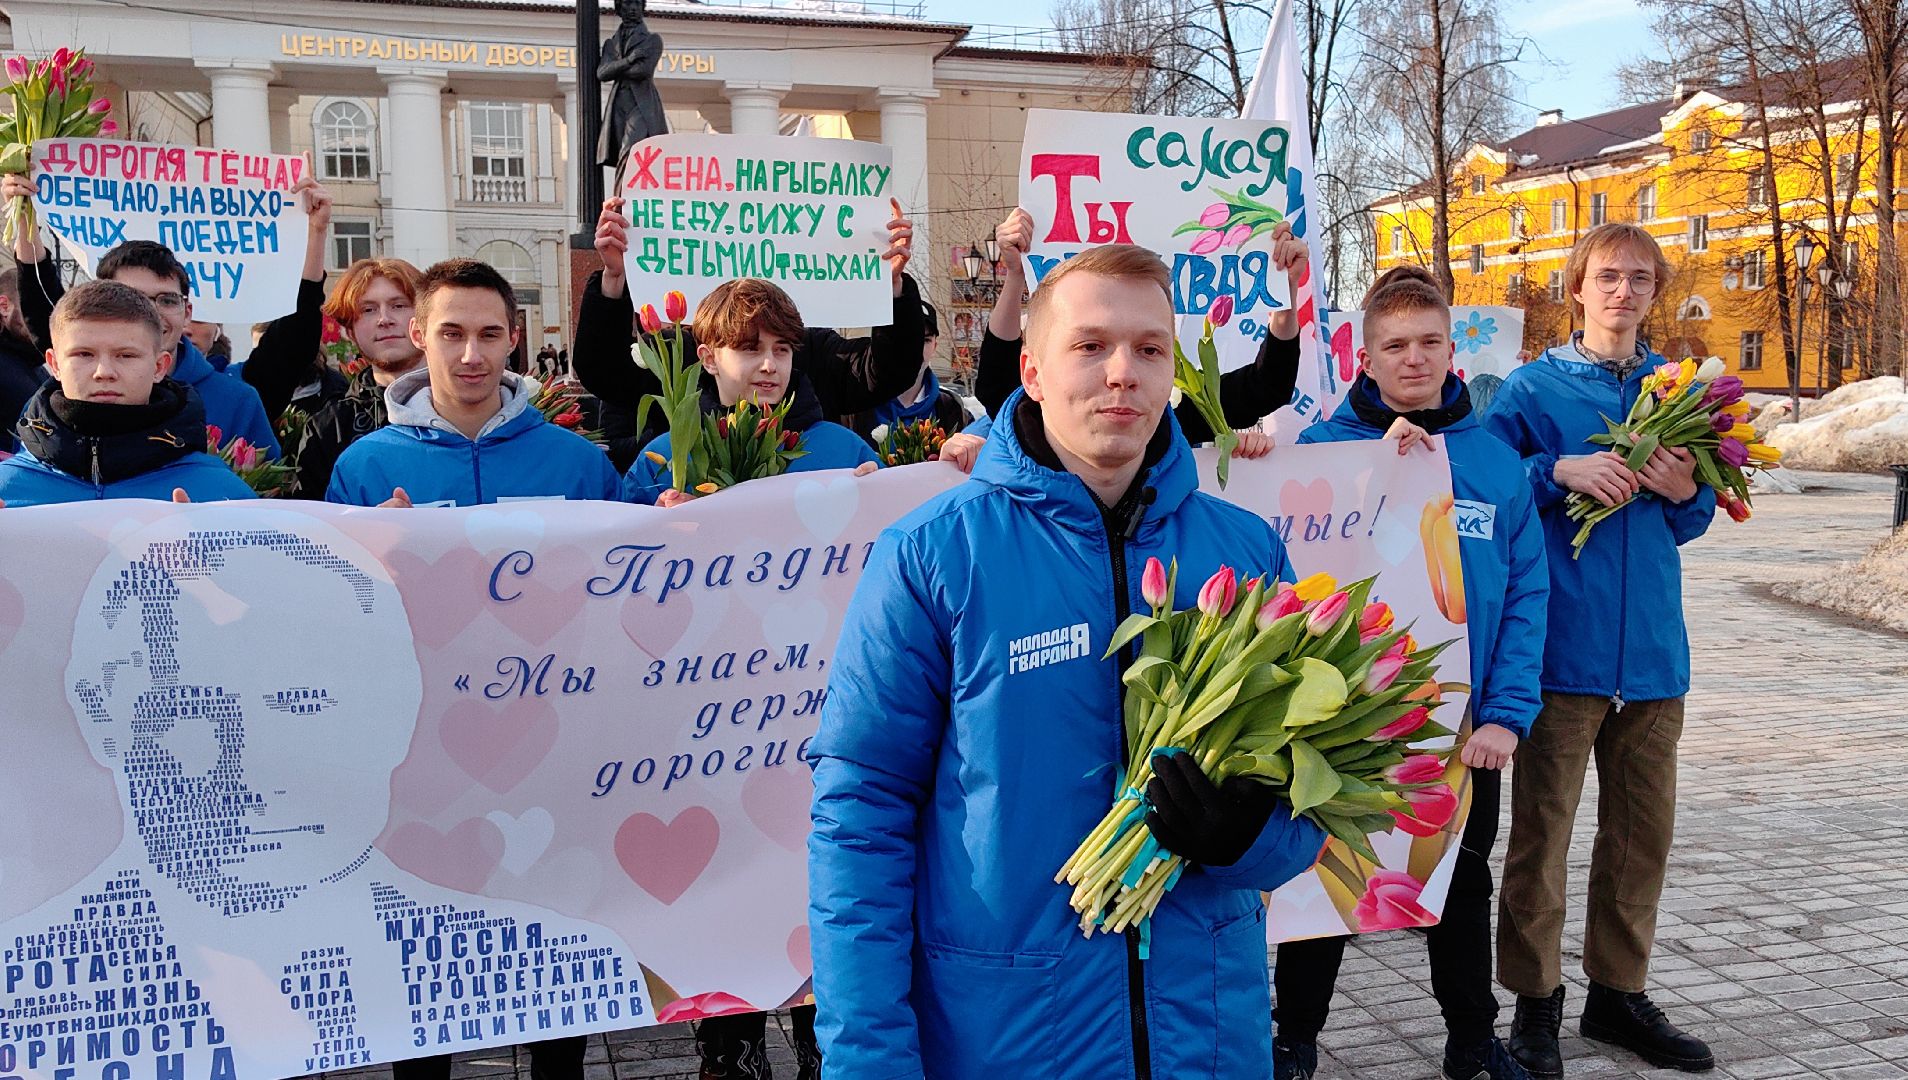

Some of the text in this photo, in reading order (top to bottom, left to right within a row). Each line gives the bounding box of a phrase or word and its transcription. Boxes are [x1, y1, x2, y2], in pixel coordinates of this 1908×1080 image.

[280, 33, 478, 64] ЦЕНТРАЛЬНЫЙ
[657, 52, 715, 73] ТУРЫ
[39, 142, 303, 191] ДОРОГАЯ ТЁЩА!
[626, 145, 891, 197] ЖЕНА, НА РЫБАЛКУ
[36, 173, 295, 218] ОБЕЩАЮ, НА ВЫХО-
[632, 199, 854, 238] НЕ ЕДУ, СИЖУ С
[158, 220, 279, 255] ПОЕДЕМ
[184, 261, 245, 300] АЧУ
[130, 560, 207, 570] ПОДДЕРЖКА
[142, 552, 208, 562] ХРАБРОСТЬ
[121, 569, 169, 580] ЧЕСТЬ
[487, 549, 535, 602] С
[113, 579, 174, 590] КРАСОТА
[1010, 623, 1090, 657] МОЛОДАЯ
[642, 643, 826, 687] знаем,
[169, 686, 223, 699] СЕМЬЯ
[277, 689, 328, 699] ПРАВДА
[170, 706, 206, 717] ДОЛГ
[290, 703, 322, 713] СИЛА
[124, 762, 182, 773] ВНИМАНИЕ
[129, 776, 185, 788] НАДЕЖДА
[130, 783, 203, 799] БУДУЩЕЕ
[222, 793, 263, 805] МАМА
[131, 796, 174, 809] ЧЕСТЬ
[138, 815, 174, 827] ДОЧЬ
[138, 819, 239, 835] ПРИВЛЕКАТЕЛЬНАЯ
[187, 826, 251, 841] БАБУШКА
[175, 842, 282, 861] ВЕРНОСТЬ ВЕСНА
[117, 869, 140, 878] ВЕРА
[157, 858, 221, 873] ВЕЛИЧИЕ
[166, 867, 219, 879] НАДЕЖНОСТЬ
[187, 881, 271, 894] СМЕЛОСТЬ ДРУЖБА
[81, 889, 152, 905] НАДЕЖНОСТЬ
[196, 890, 237, 903] СЕСТРА
[74, 900, 157, 922] ПРАВДА
[223, 899, 285, 916] ДОБРОТА
[376, 904, 455, 921] РАЗУМНОСТЬ
[49, 915, 161, 932] МИЛОСЕРДИЕ ТРАДИЦИИ
[385, 909, 485, 942] МИР опора
[443, 916, 516, 934] СТАБИЛЬНОСТЬ
[15, 926, 118, 949] ОЧАРОВАНИЕ
[401, 922, 588, 966] РОССИЯ тепло
[5, 933, 164, 963] РЕШИТЕЛЬНОСТЬ
[108, 945, 177, 967] СЕМЬЯ
[301, 946, 344, 960] разум
[123, 962, 182, 983] СИЛА
[283, 957, 352, 974] интелект
[401, 947, 613, 983] ТРУДОЛЮБИЕ будущее
[280, 970, 350, 994] СИЛА
[408, 957, 623, 1006] ПРОЦВЕТАНИЕ
[14, 991, 78, 1009] ЛЮБОВЬ
[95, 980, 200, 1013] ЖИЗНЬ
[290, 988, 353, 1010] ОПОРА
[7, 1000, 92, 1020] ПРЕДАННОСТЬ
[308, 1005, 356, 1020] ПРАВДА
[413, 996, 643, 1047] ЗАЩИТНИКОВ
[319, 1024, 354, 1040] ВЕРА
[313, 1036, 365, 1055] ТЕПЛО
[305, 1050, 371, 1071] УСПЕХ
